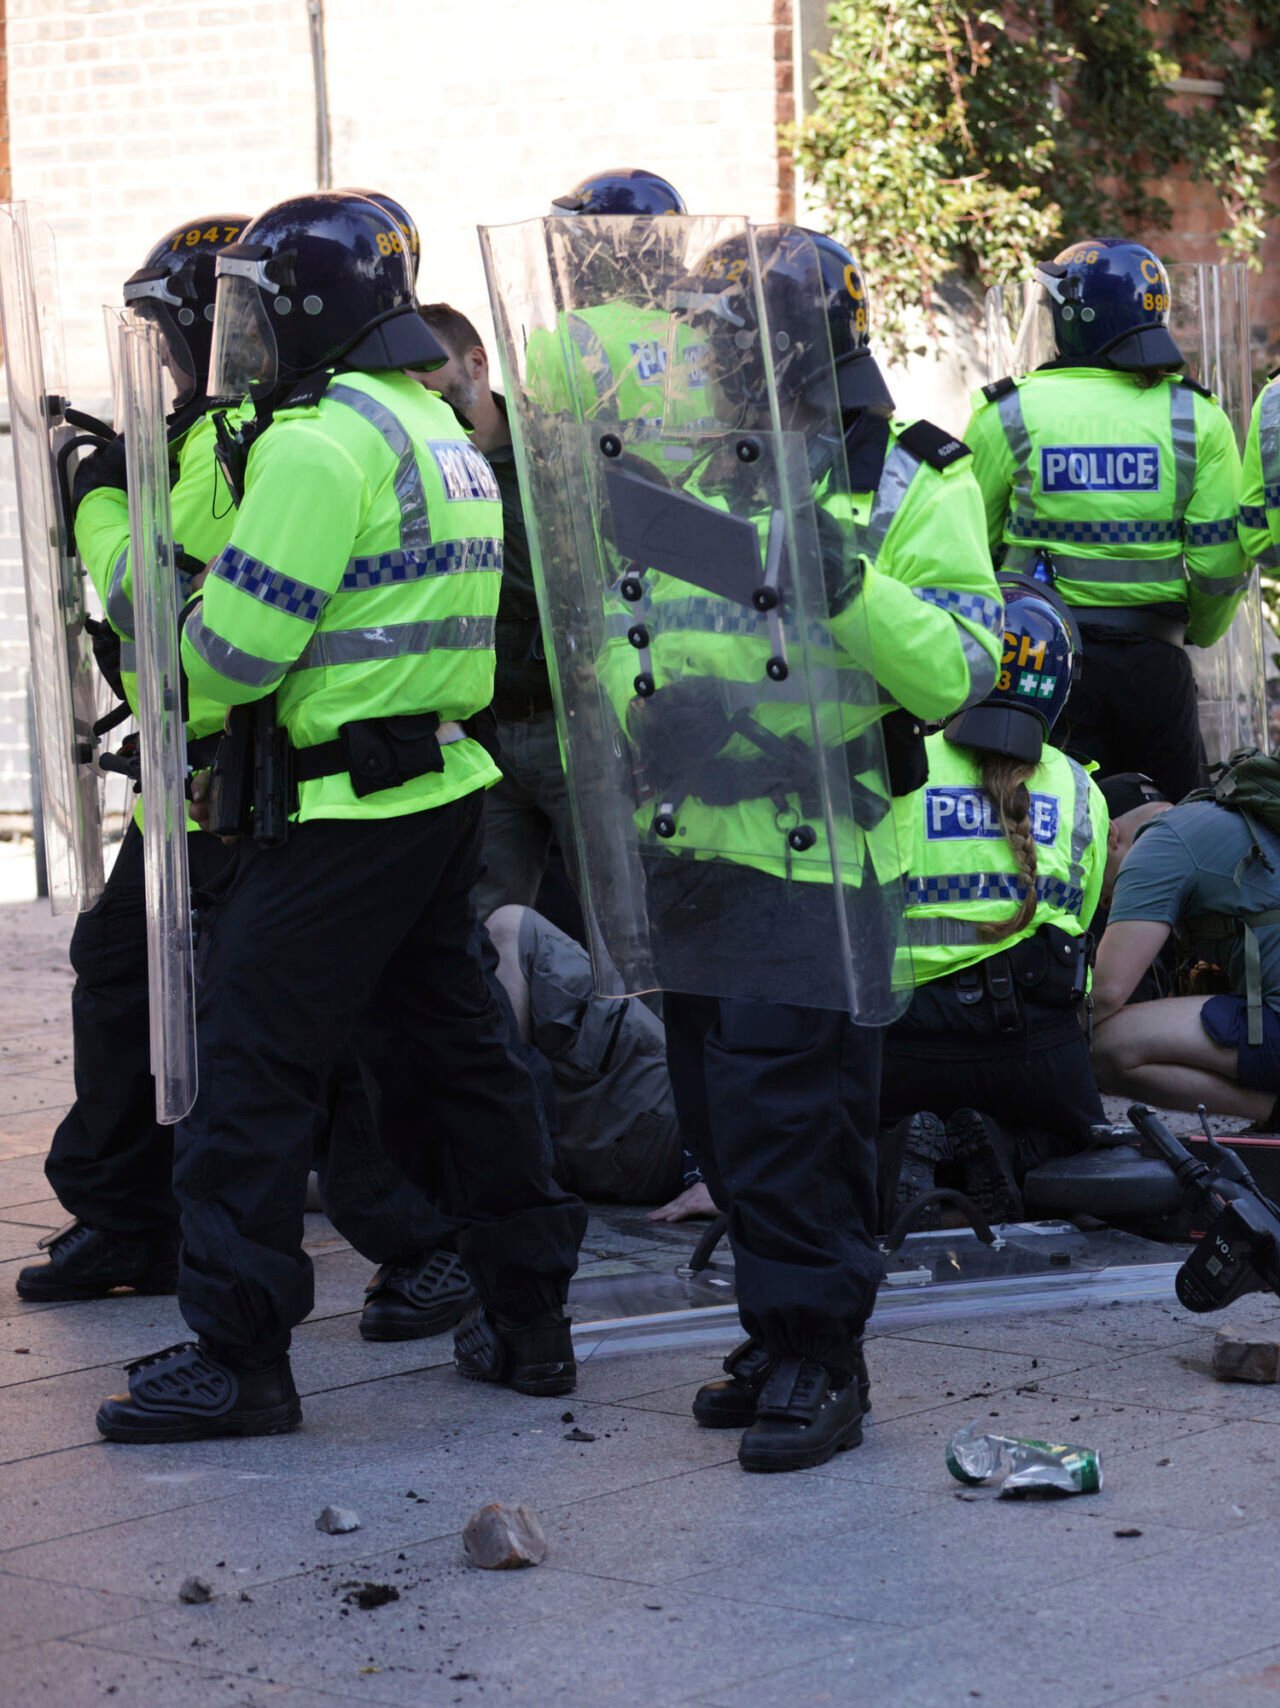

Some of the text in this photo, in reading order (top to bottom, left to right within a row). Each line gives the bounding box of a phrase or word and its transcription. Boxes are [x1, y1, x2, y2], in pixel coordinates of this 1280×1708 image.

[171, 226, 240, 251] 7947
[1046, 452, 1154, 485] POLICE
[1001, 631, 1046, 671] CH
[931, 795, 1051, 837] POLE
